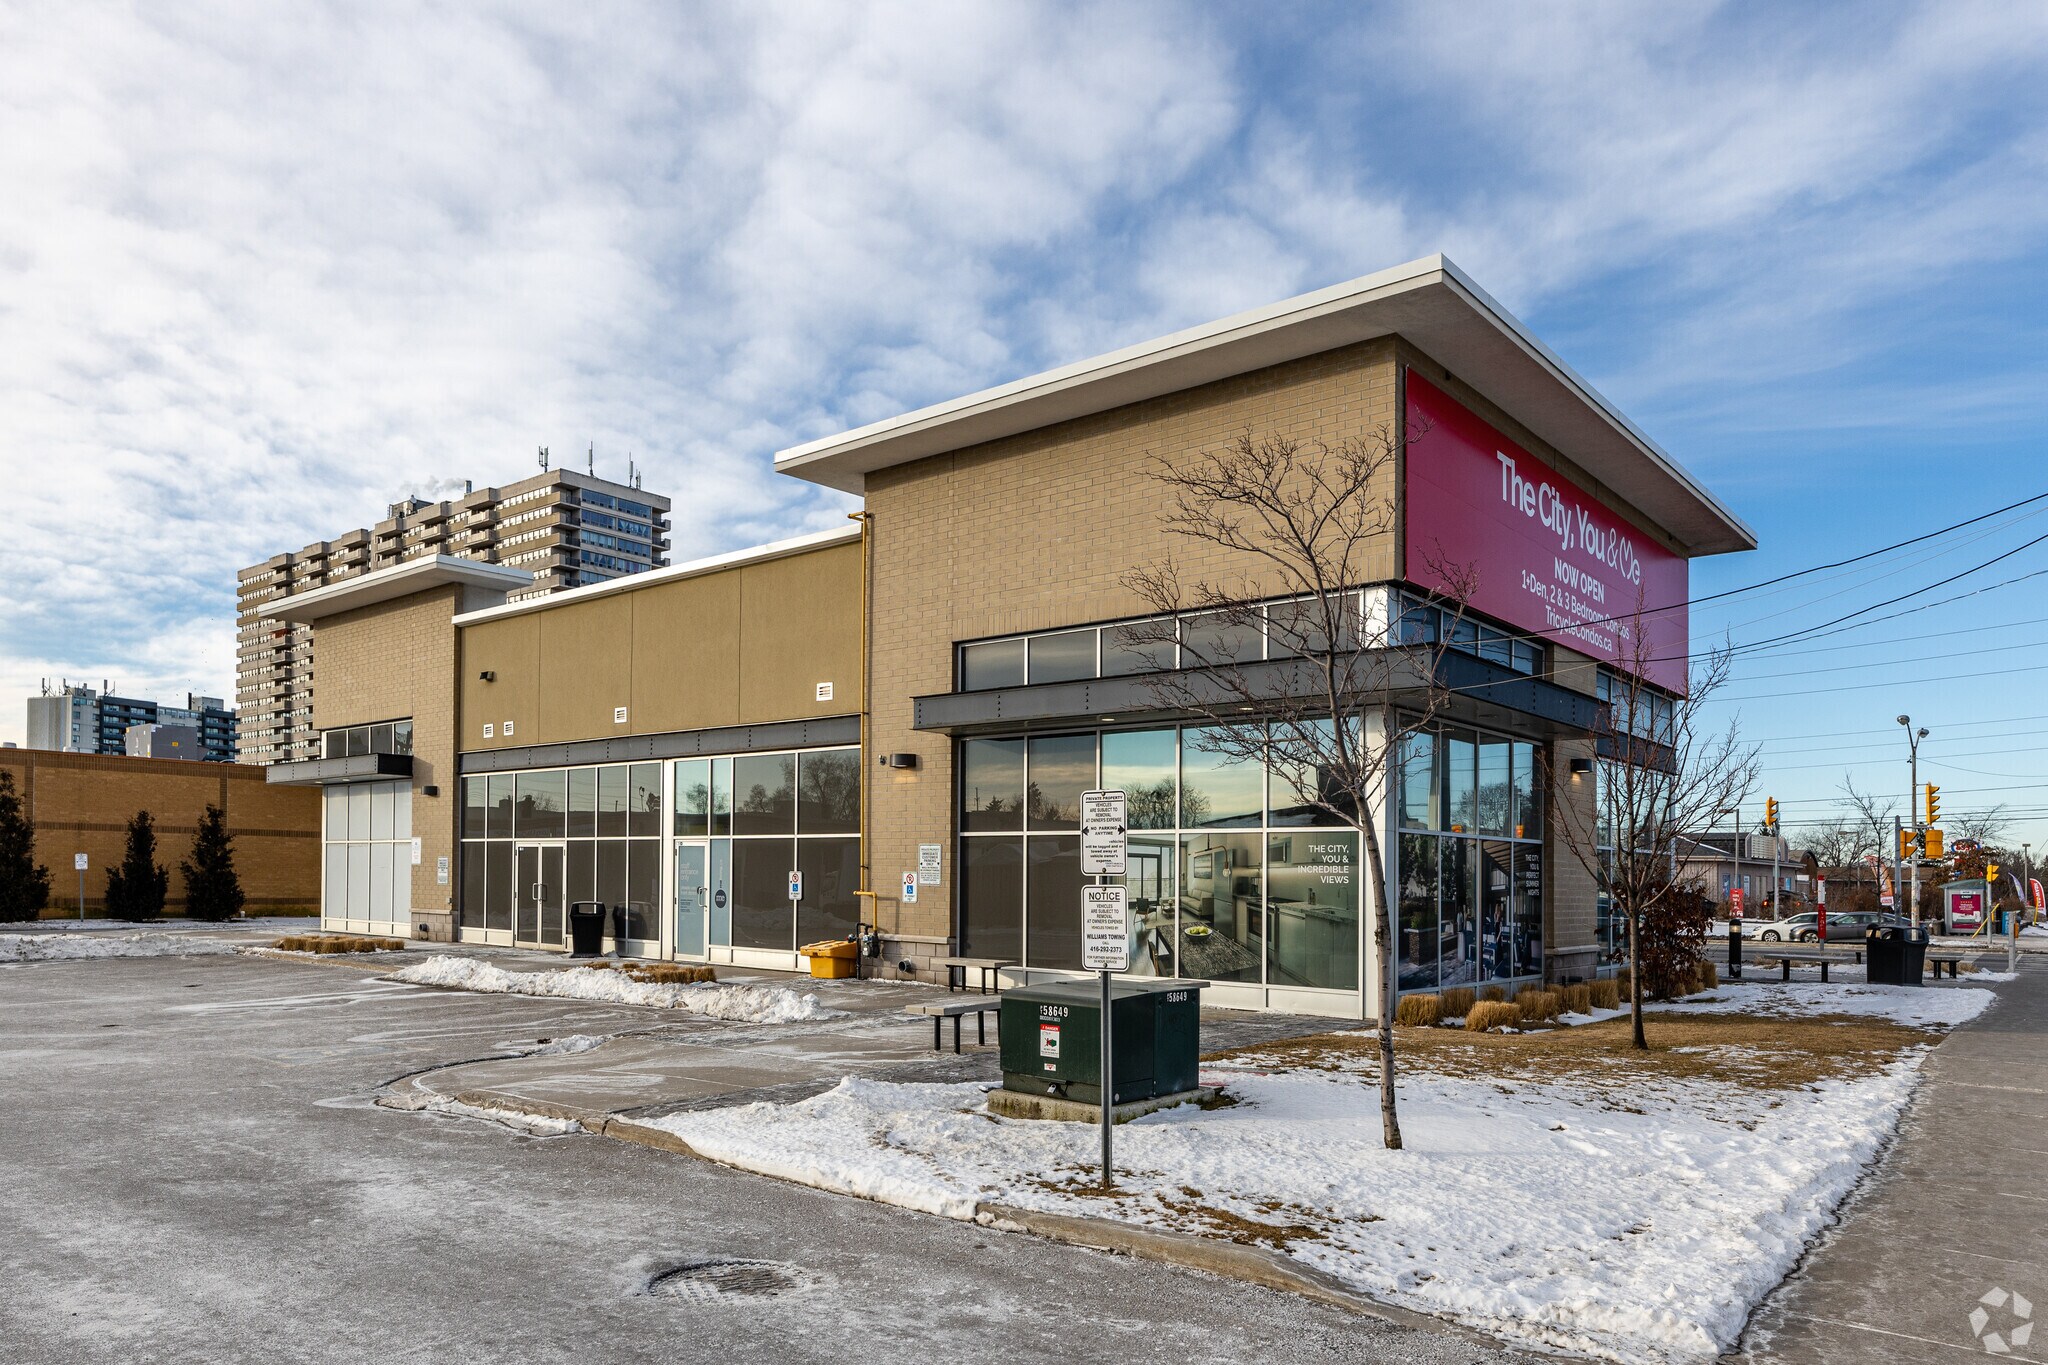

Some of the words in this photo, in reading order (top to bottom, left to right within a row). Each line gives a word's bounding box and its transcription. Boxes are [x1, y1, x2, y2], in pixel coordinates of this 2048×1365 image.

[1497, 450, 1536, 518] The
[1538, 482, 1574, 551] City,
[1576, 504, 1605, 562] You
[1607, 528, 1618, 570] &
[1554, 556, 1579, 589] NOW
[1580, 572, 1605, 605] OPEN
[1550, 584, 1556, 603] 2
[1557, 588, 1563, 608] &
[1564, 592, 1570, 611] 3
[1571, 595, 1604, 628] Bedroom
[1545, 605, 1613, 653] TricycleCondos.ca
[1308, 845, 1326, 853] THE
[1327, 845, 1349, 854] CITY,
[1321, 855, 1341, 863] YOU
[1342, 855, 1349, 863] &
[1297, 865, 1350, 874] INCREDIBLE
[1320, 875, 1350, 884] VIEWS
[1088, 892, 1120, 901] NOTICE
[1043, 1005, 1069, 1018] 58649
